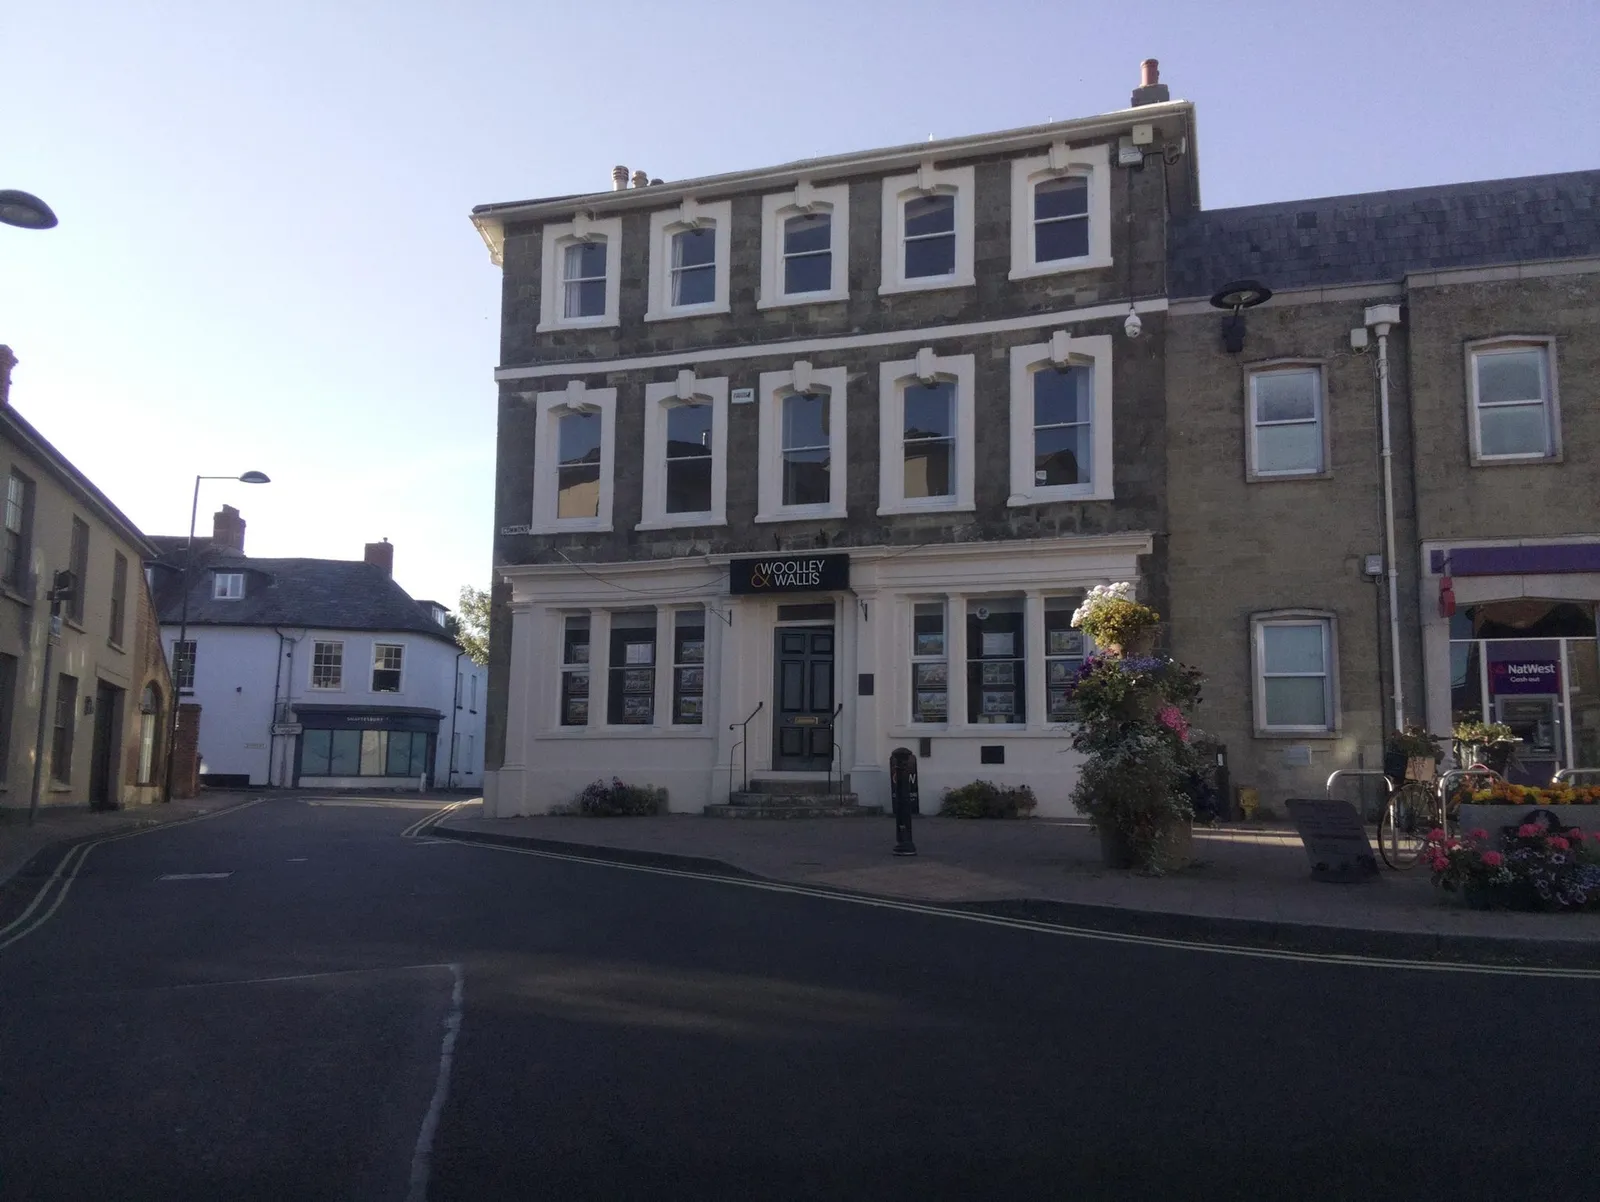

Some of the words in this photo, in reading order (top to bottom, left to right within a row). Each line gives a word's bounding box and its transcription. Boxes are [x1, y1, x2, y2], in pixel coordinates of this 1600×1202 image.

[760, 560, 825, 575] WOOLLEY
[751, 563, 771, 588] &
[774, 572, 820, 586] WALLIS
[1508, 664, 1556, 674] NatWest
